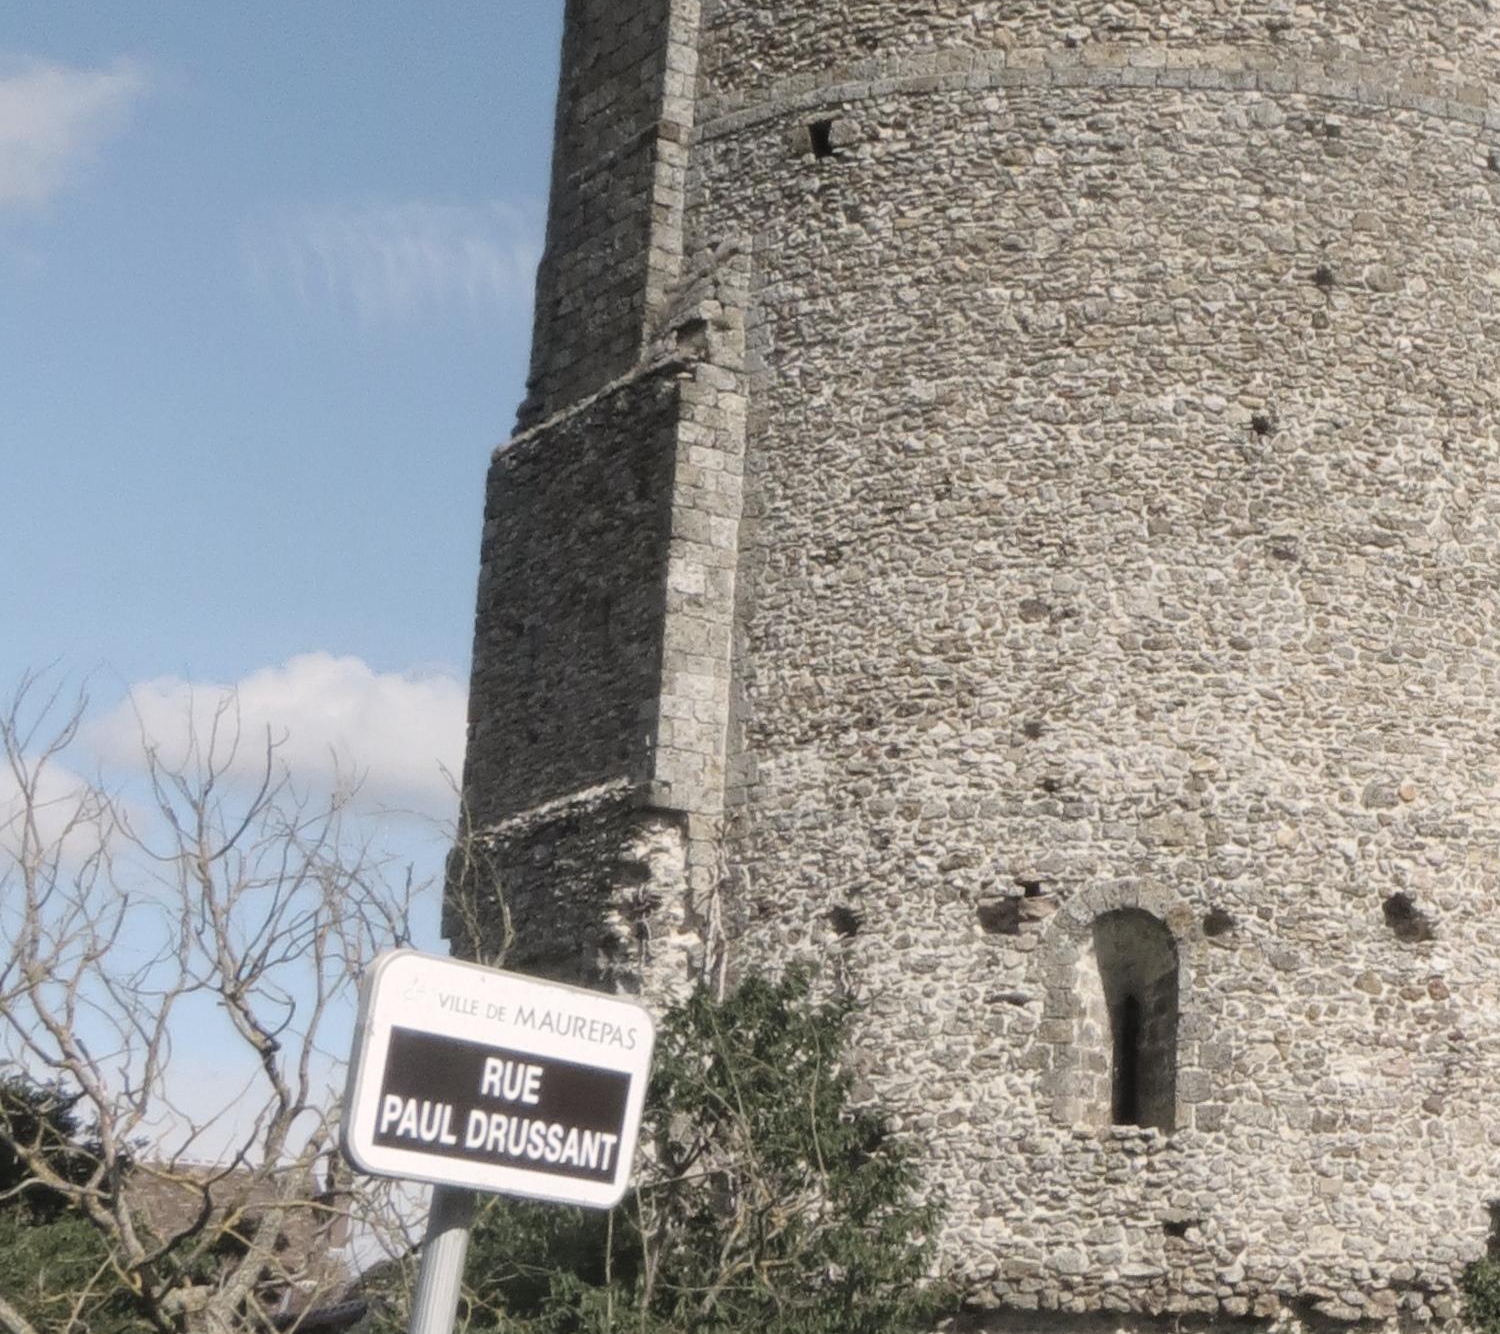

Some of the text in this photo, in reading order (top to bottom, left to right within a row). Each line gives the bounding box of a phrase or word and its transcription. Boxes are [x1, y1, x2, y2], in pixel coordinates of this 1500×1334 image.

[438, 992, 639, 1051] VILLE DE MAUREPAS
[480, 1056, 544, 1105] RUE
[379, 1093, 618, 1171] PAUL DRUSSANT
